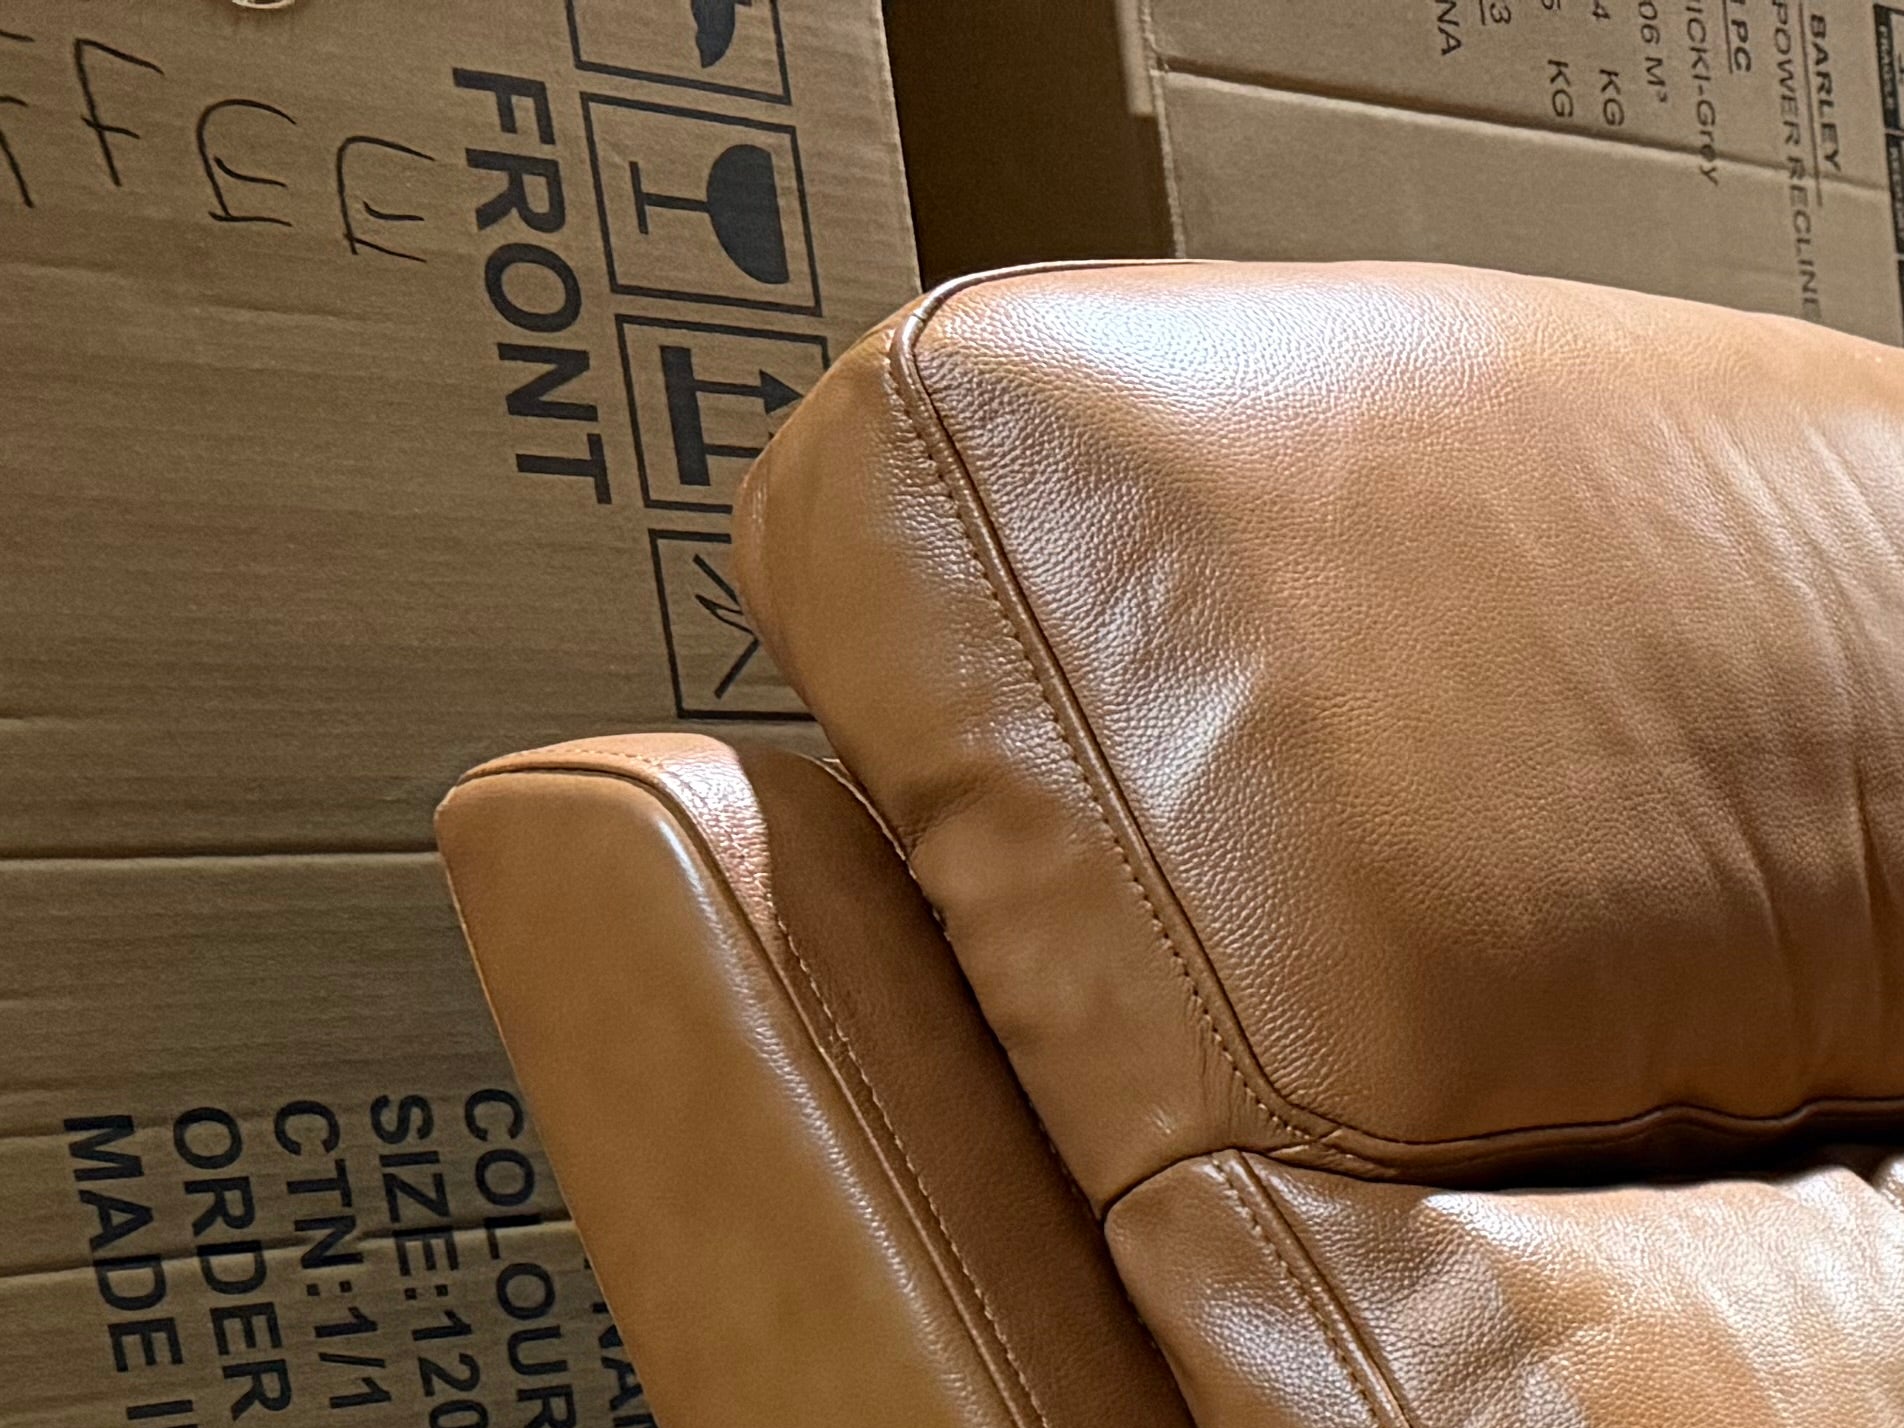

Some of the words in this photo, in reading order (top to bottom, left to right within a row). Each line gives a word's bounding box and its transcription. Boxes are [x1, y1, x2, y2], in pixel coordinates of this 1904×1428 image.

[1547, 59, 1574, 118] KG
[1599, 68, 1625, 127] KG
[1771, 0, 1801, 147] POWER
[1810, 13, 1842, 173] BARLEY
[452, 67, 613, 505] FRONT
[63, 1114, 184, 1373] MADE
[172, 1106, 293, 1422] ORDER
[273, 1100, 393, 1410] CTN:1/1
